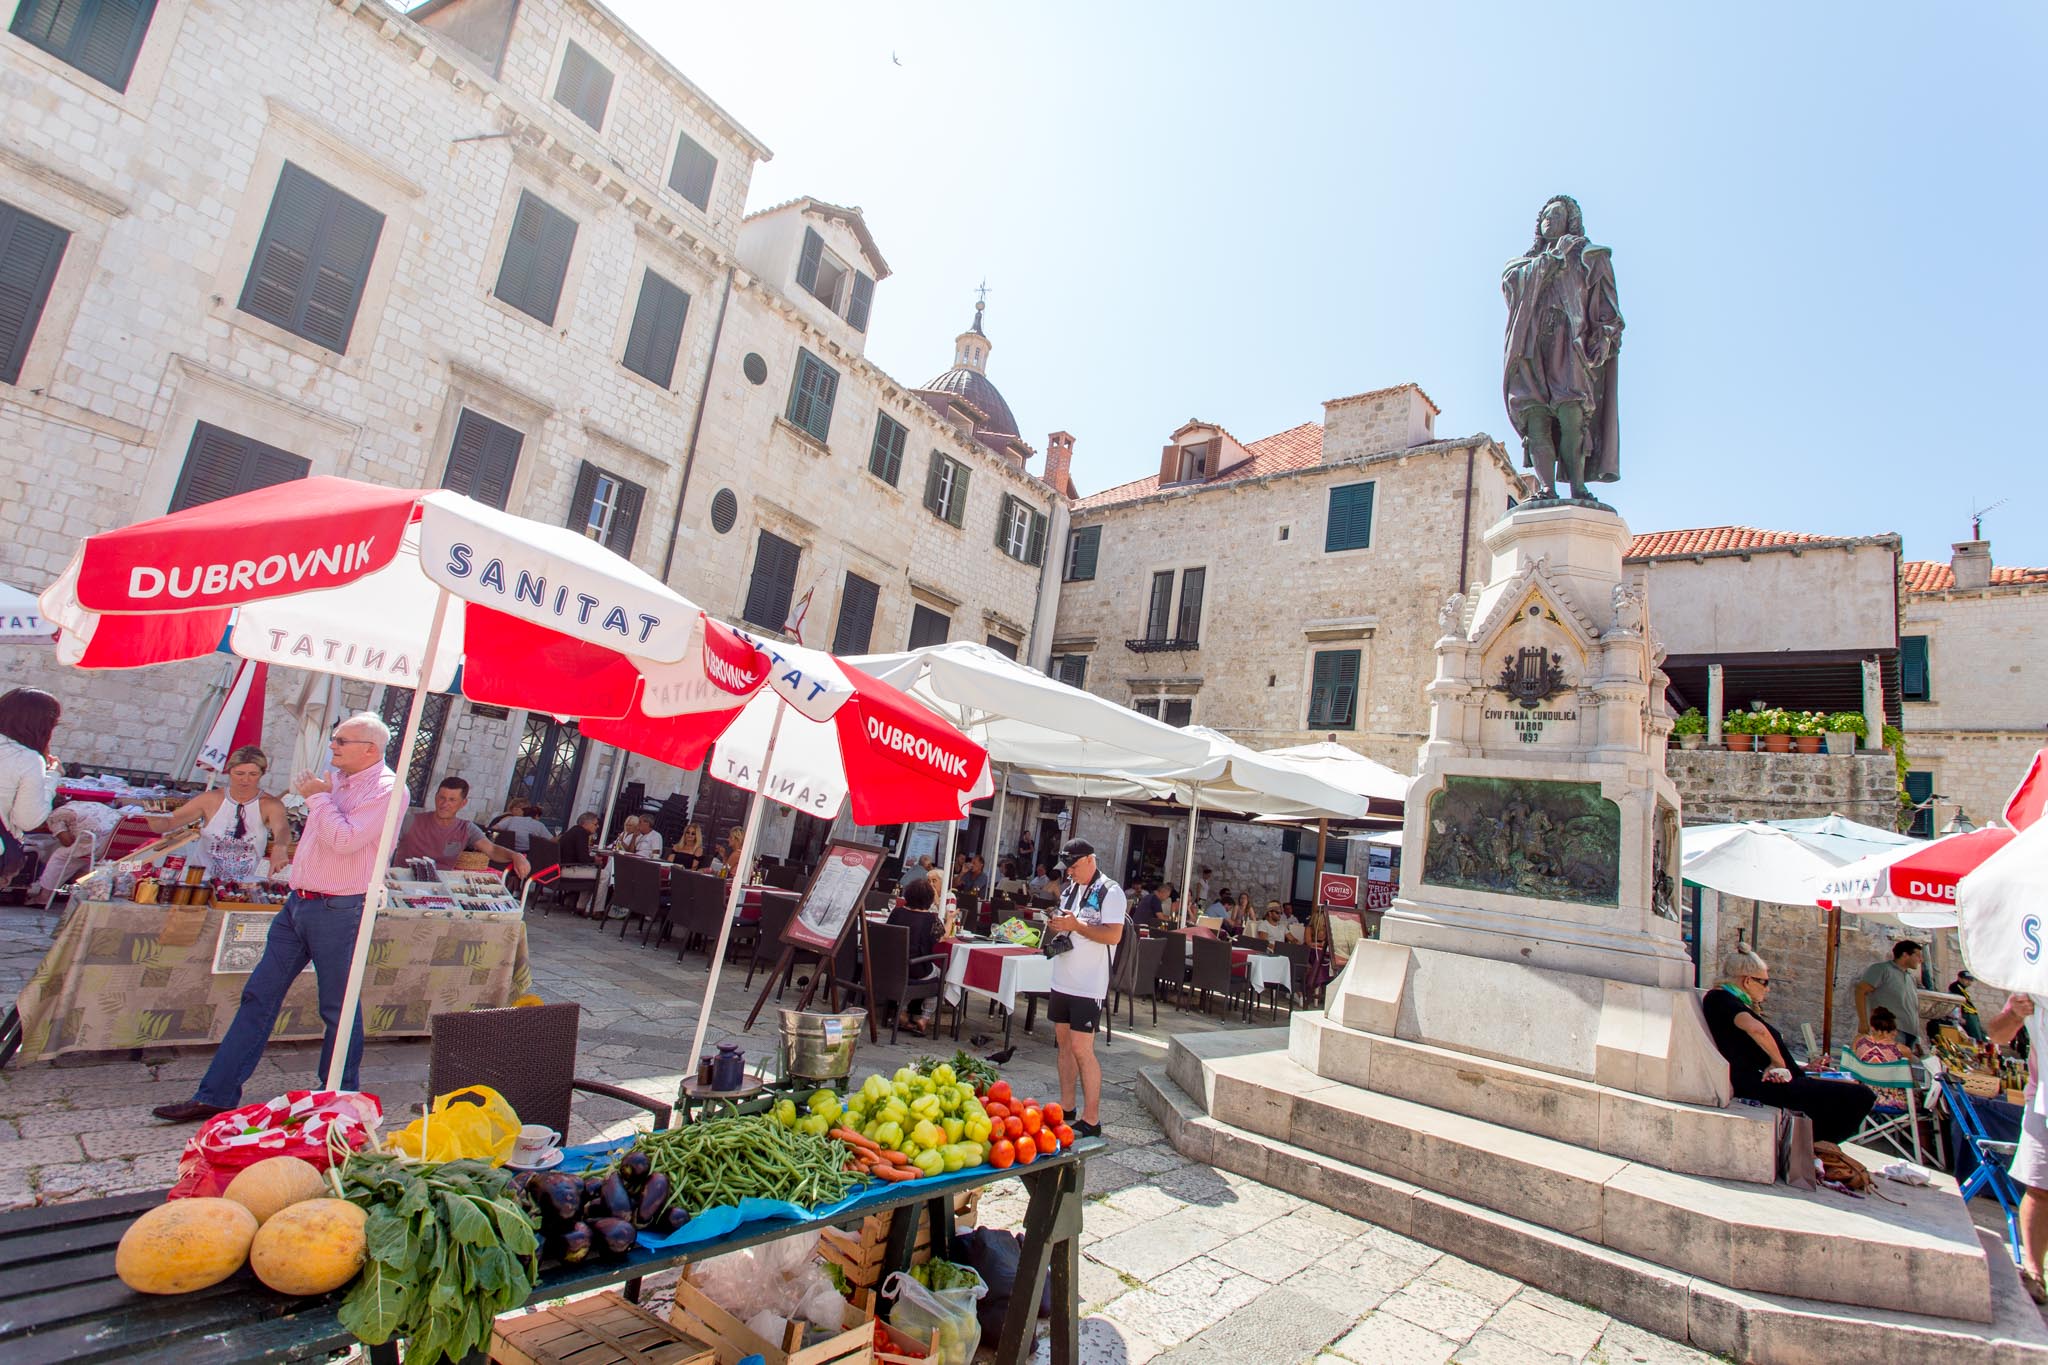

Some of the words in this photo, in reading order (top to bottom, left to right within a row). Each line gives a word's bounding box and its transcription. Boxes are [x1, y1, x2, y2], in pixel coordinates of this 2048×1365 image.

[128, 535, 376, 599] DUBROVNIK
[447, 542, 661, 643] SANITAT
[1514, 721, 1543, 732] NAROD
[1519, 732, 1539, 743] 1893
[867, 716, 968, 779] DUBROVNIK
[1327, 885, 1350, 895] VERITAS
[1368, 884, 1390, 894] TRIO
[1821, 878, 1878, 894] SANITA
[2021, 912, 2042, 964] S
